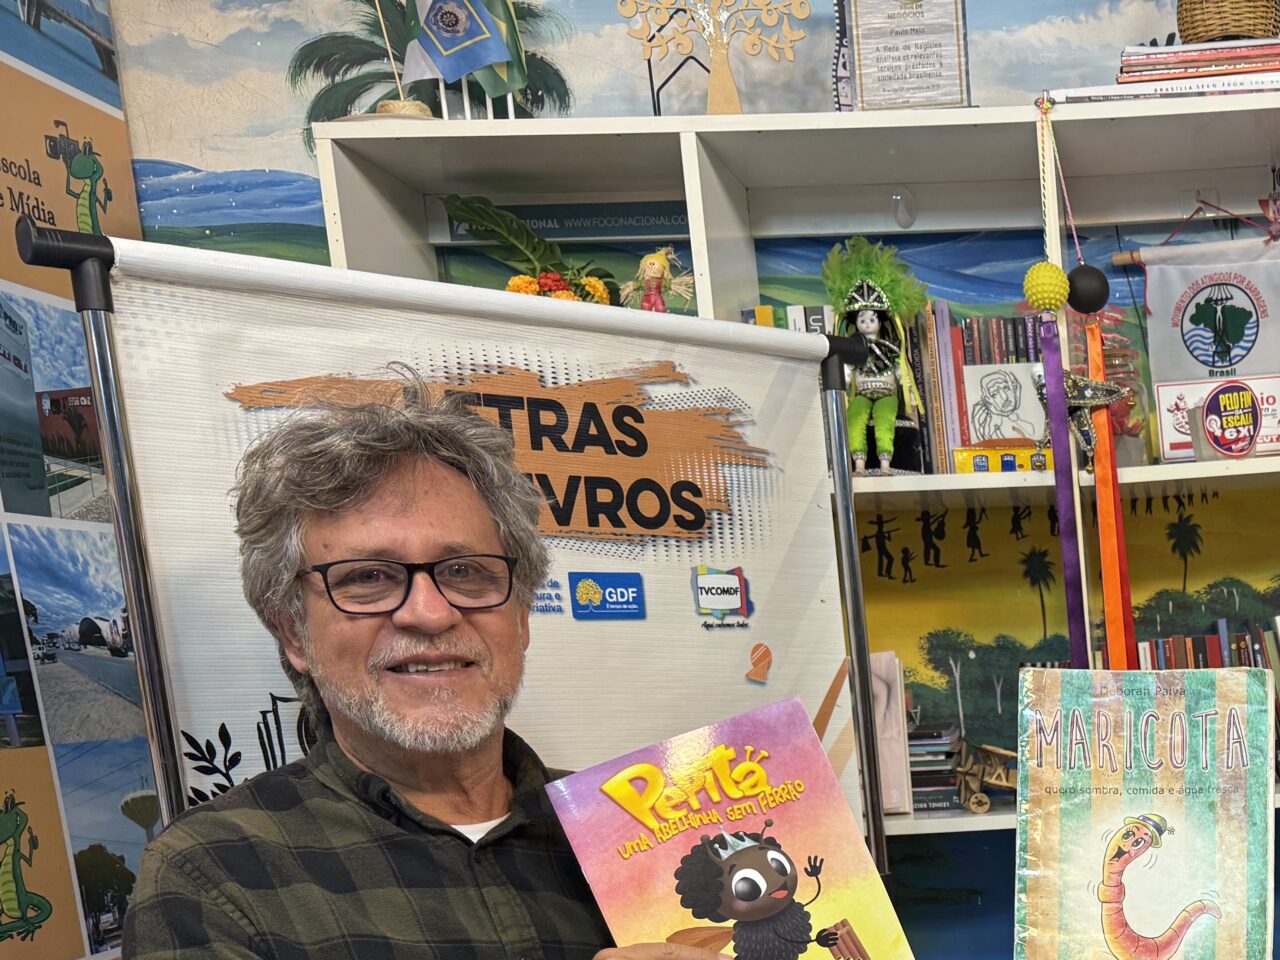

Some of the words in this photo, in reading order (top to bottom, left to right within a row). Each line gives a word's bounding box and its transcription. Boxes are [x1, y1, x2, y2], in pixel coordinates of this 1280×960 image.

[0, 157, 42, 187] scola
[7, 186, 57, 227] Mídia
[1233, 273, 1247, 286] POR
[1208, 368, 1237, 377] Brasil
[1219, 391, 1239, 411] PELO
[445, 387, 648, 458] TRAS
[526, 472, 706, 531] VROS
[605, 587, 638, 603] GDF
[699, 586, 741, 596] TVCOMDF
[533, 603, 563, 613] riativa
[1155, 685, 1186, 697] Paiva
[1034, 707, 1249, 773] MARICOTA
[757, 779, 806, 814] FERRÃO
[1045, 785, 1077, 798] quero
[1079, 783, 1123, 797] sombra,
[1127, 783, 1165, 795] comida
[1168, 786, 1175, 795] e
[1177, 783, 1204, 798] água
[1207, 783, 1239, 795] fresca
